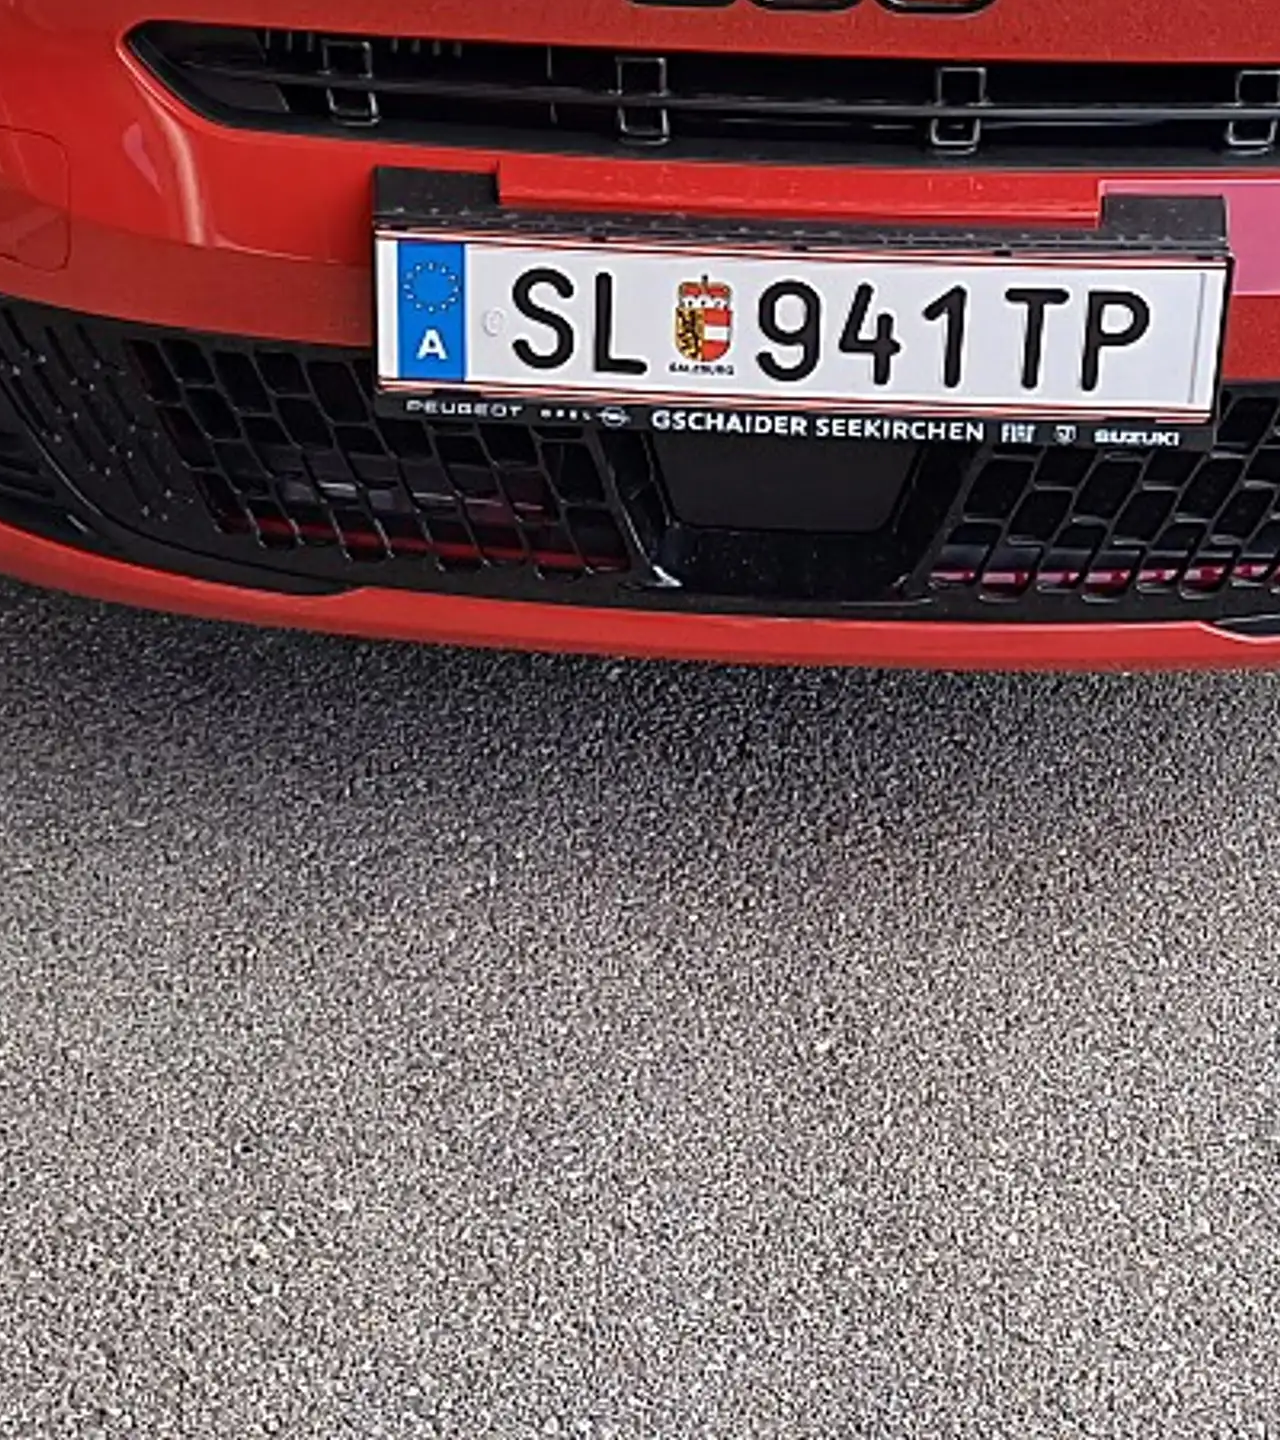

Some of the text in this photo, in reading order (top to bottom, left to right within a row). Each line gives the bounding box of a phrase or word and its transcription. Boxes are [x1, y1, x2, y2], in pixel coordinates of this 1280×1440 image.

[416, 329, 447, 361] A
[511, 268, 648, 376] SL
[406, 399, 523, 418] PEUGEOT
[650, 409, 809, 437] GSCHAIDER
[816, 416, 985, 442] SEEKIRCHEN
[1094, 428, 1179, 446] SUZUKI
